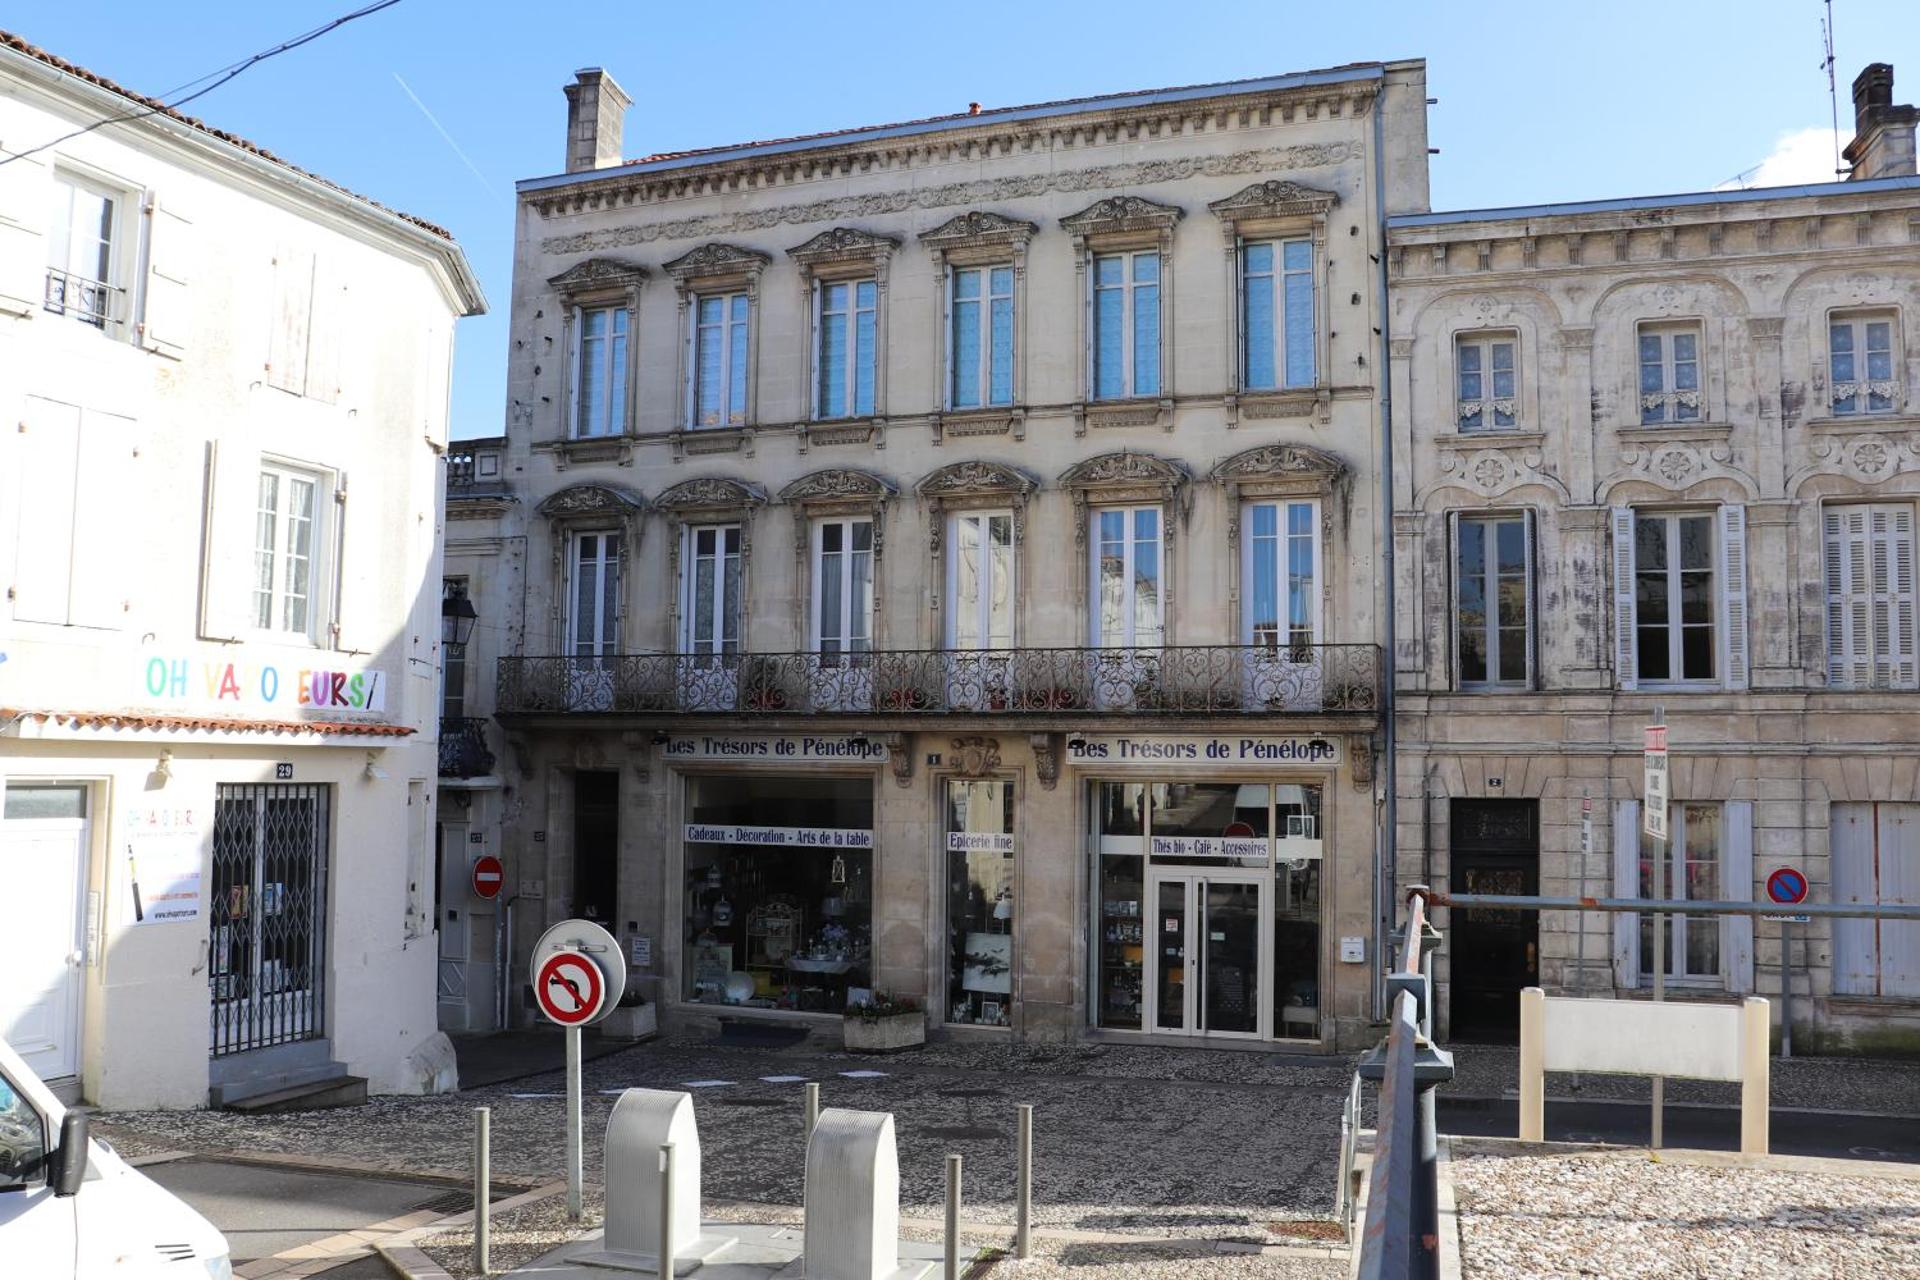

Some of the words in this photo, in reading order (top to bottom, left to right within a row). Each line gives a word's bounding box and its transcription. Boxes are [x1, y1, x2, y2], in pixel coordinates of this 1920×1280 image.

[146, 656, 188, 698] OH
[666, 737, 696, 754] Les
[702, 737, 768, 755] Trésors
[775, 738, 796, 756] de
[802, 737, 883, 759] Pénélope
[1117, 739, 1197, 758] Trésors
[1206, 740, 1229, 759] de
[1239, 739, 1335, 762] Pénélope
[278, 764, 292, 777] 29
[688, 826, 725, 841] Cadeaux
[736, 827, 785, 843] Décoration
[797, 830, 816, 844] Arts
[819, 831, 831, 845] de
[834, 832, 843, 845] la
[847, 832, 870, 846] table
[950, 833, 990, 849] Epicerie
[994, 835, 1012, 849] fine
[1153, 839, 1171, 853] Thés
[1174, 839, 1185, 854] bio
[1194, 839, 1212, 855] Café
[1220, 840, 1267, 856] Accessoires
